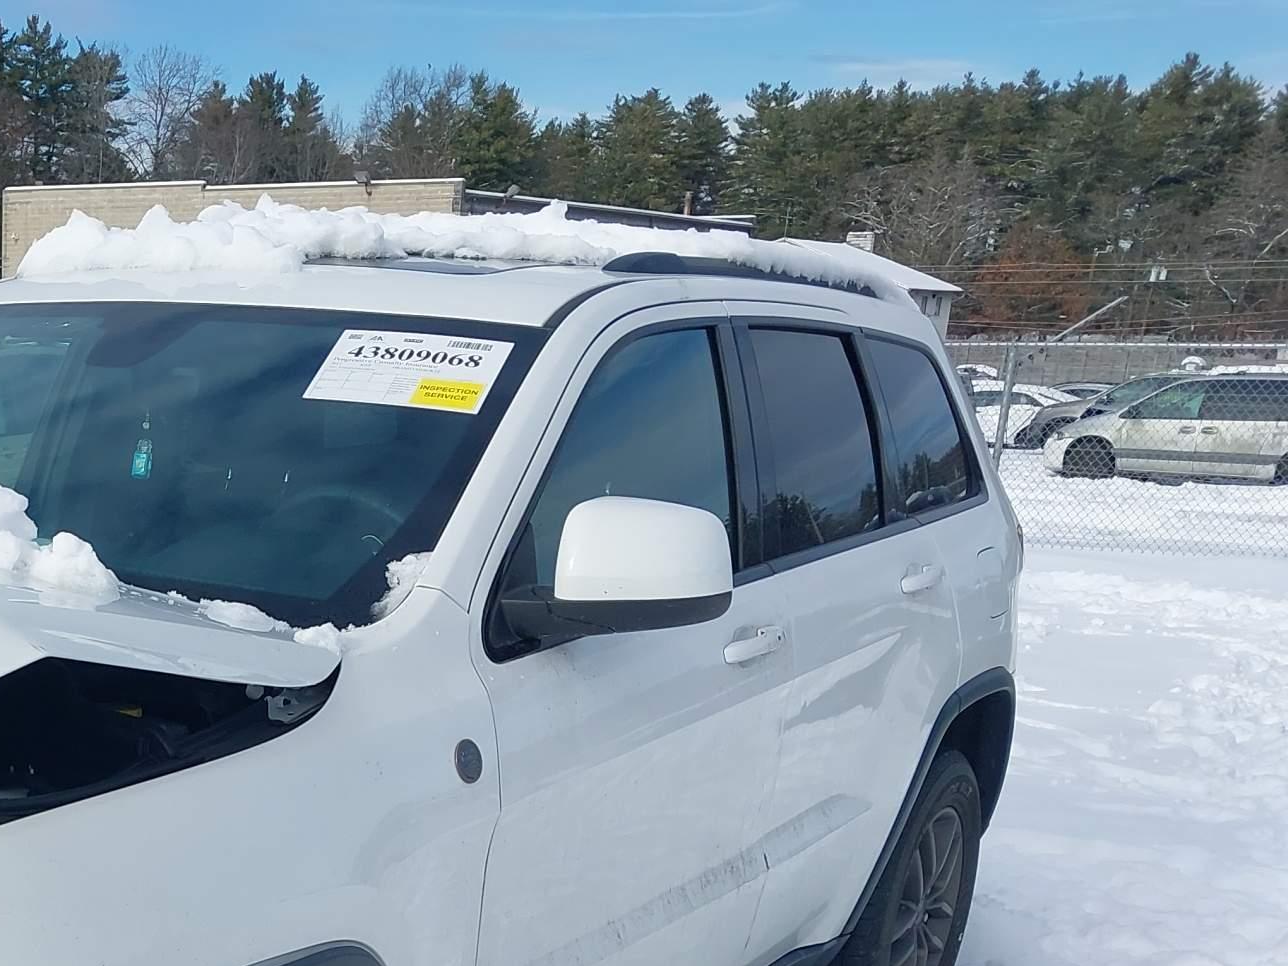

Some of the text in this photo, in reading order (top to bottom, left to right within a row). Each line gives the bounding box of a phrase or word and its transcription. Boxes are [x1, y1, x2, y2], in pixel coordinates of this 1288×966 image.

[348, 345, 483, 368] 43809068
[419, 384, 479, 396] INSPECTION
[423, 391, 468, 401] SERVICE
